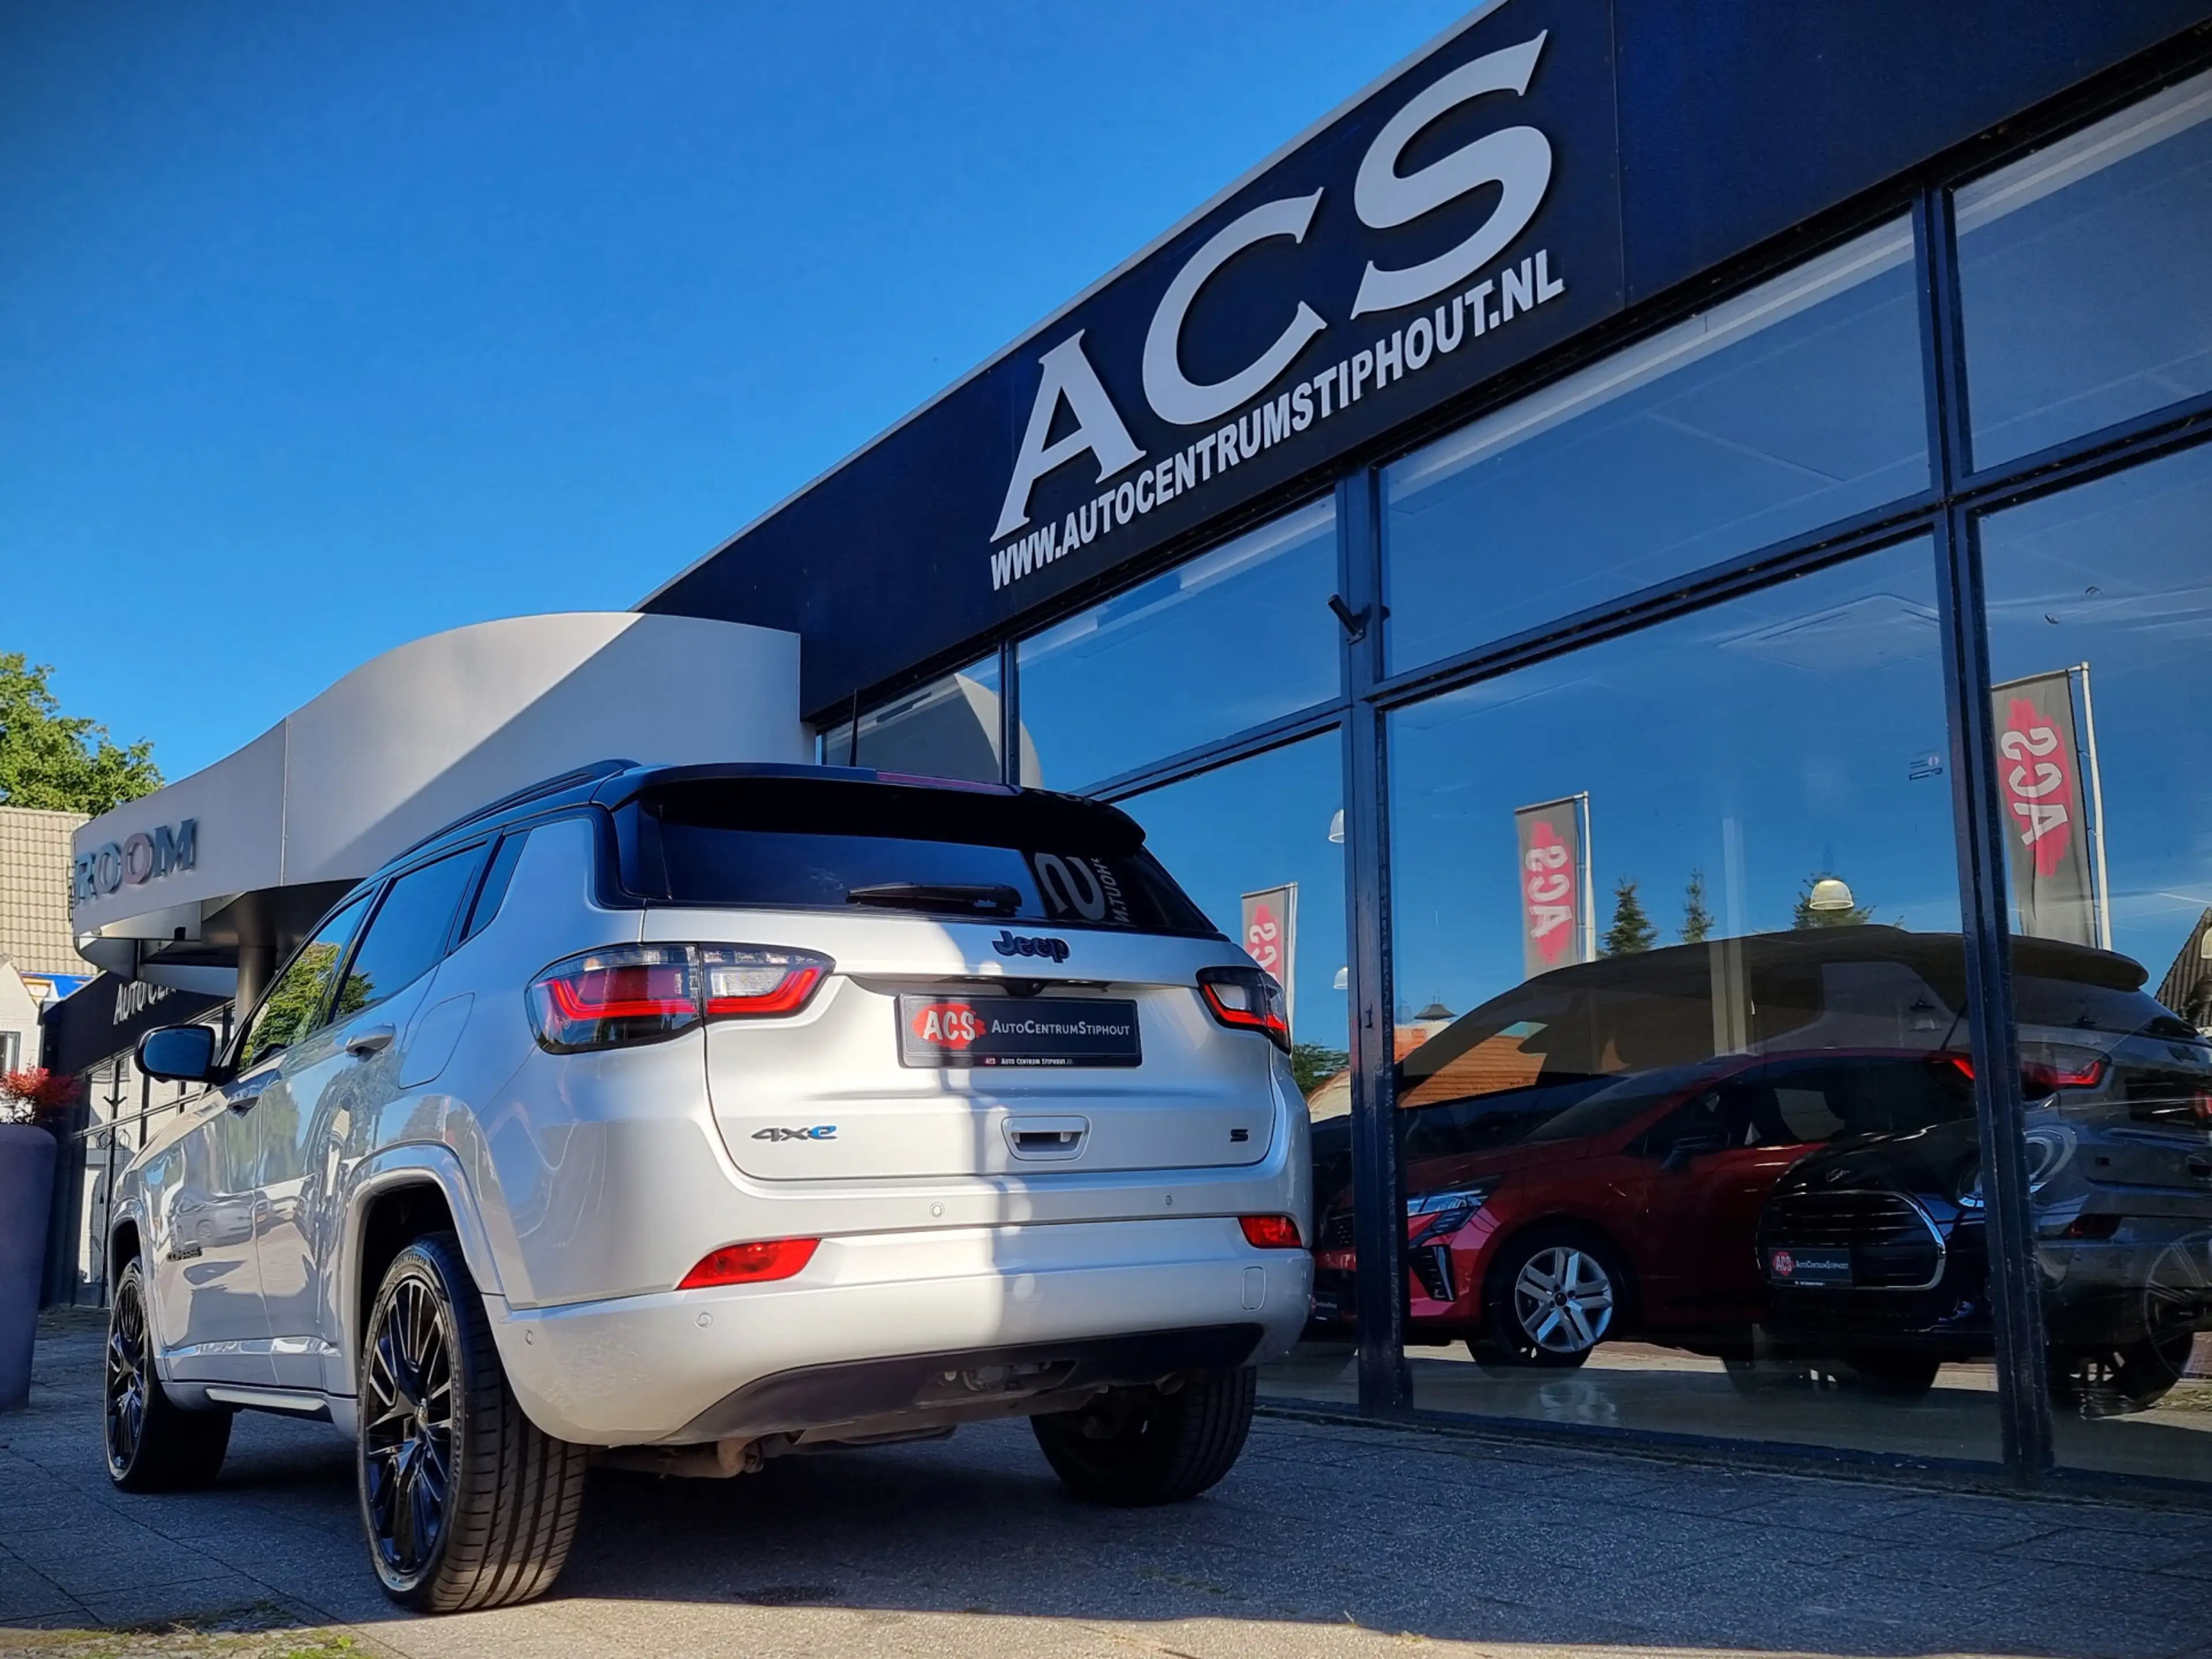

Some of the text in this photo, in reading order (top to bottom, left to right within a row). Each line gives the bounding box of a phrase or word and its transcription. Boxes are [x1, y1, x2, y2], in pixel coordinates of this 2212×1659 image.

[990, 29, 1552, 543] ACS
[990, 249, 1565, 590] WWW.AUTOCENTRUMSTIPHOUT.NL
[922, 1010, 976, 1041] ACS
[991, 929, 1070, 964] Jeep
